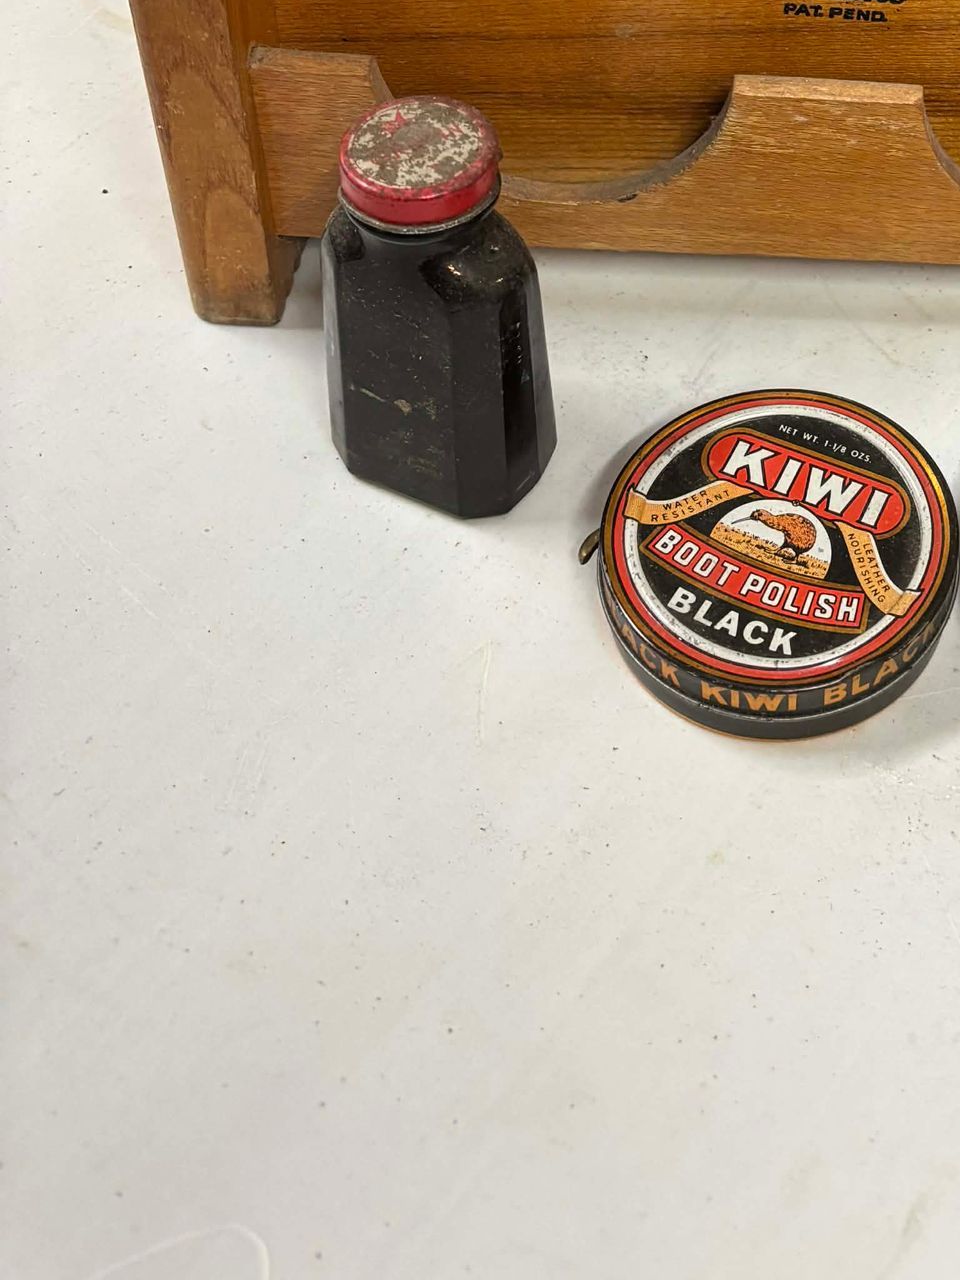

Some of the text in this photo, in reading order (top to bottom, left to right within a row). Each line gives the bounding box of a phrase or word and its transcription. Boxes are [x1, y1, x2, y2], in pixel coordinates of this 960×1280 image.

[779, 425, 872, 464] NET WT. 1-1/8 OZS.
[651, 490, 730, 522] RESISTANT
[662, 490, 708, 510] WATER
[721, 441, 889, 527] KIWI
[654, 529, 860, 622] BOOT POLISH
[847, 532, 886, 603] NOURISHING
[863, 543, 890, 592] LEATHER
[667, 587, 797, 655] BLACK
[700, 682, 799, 712] KIWI
